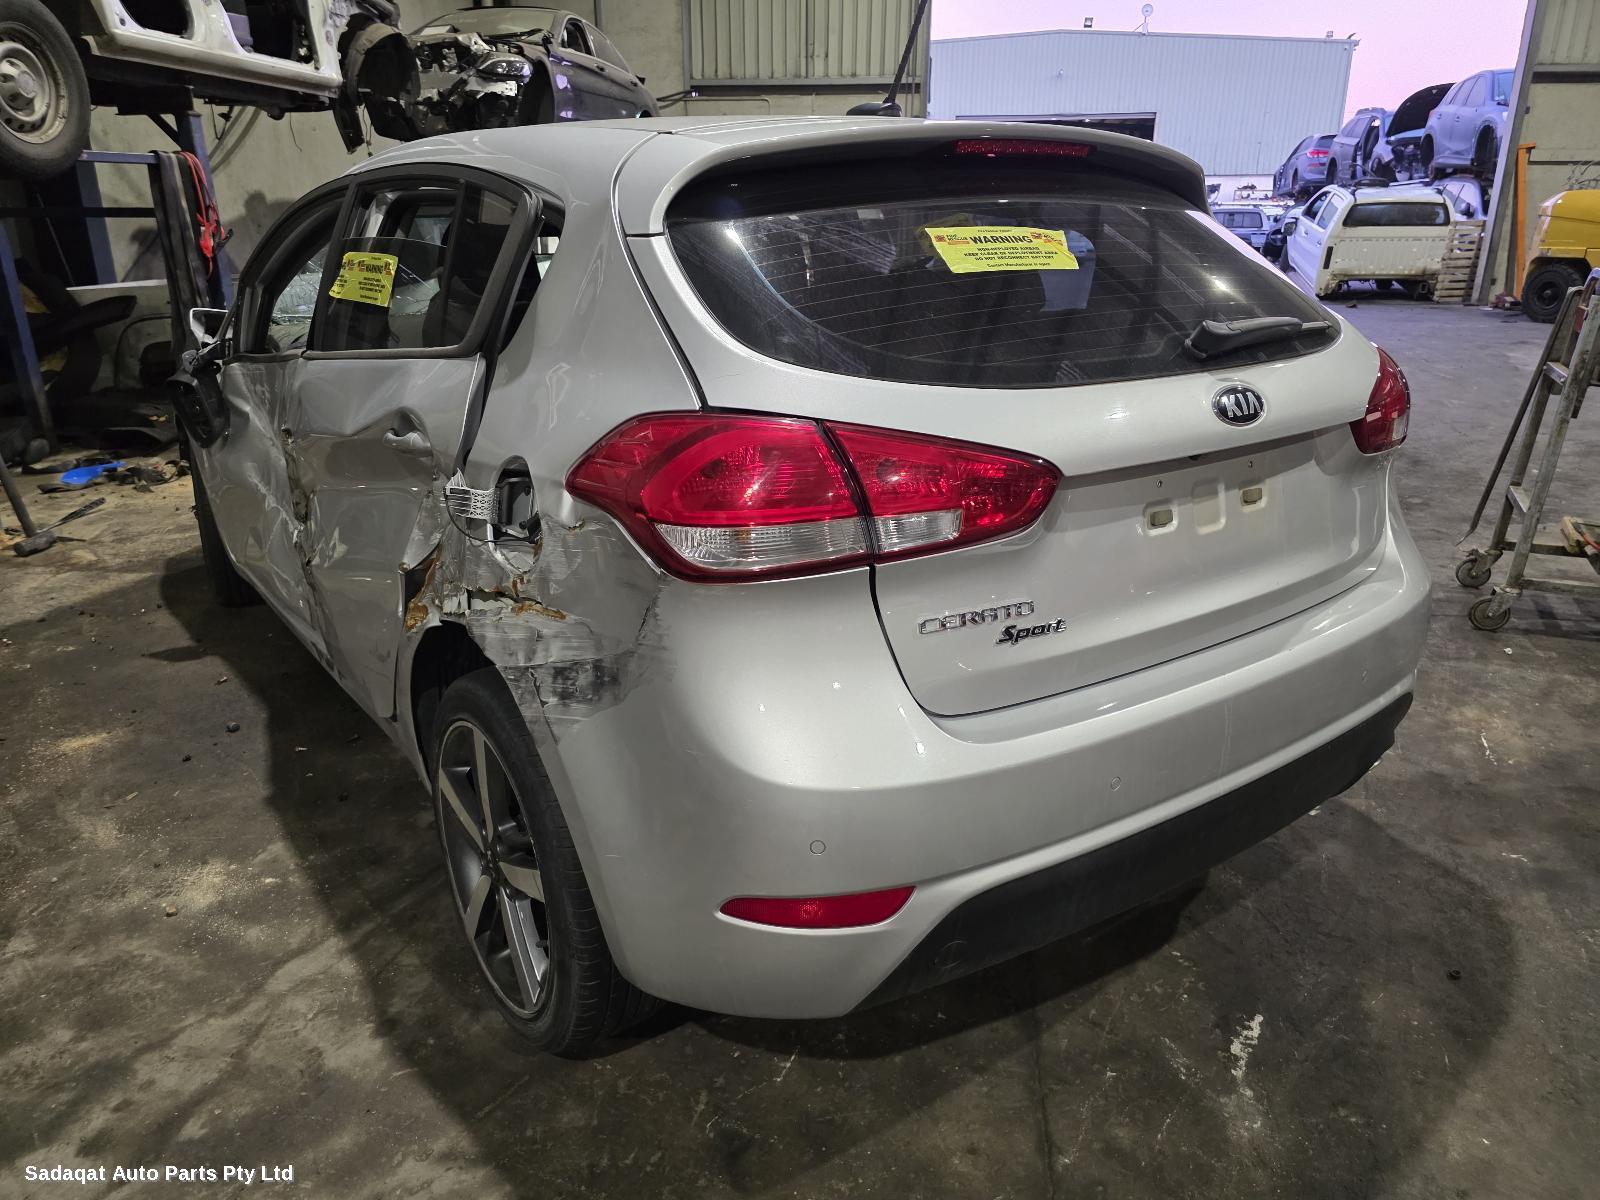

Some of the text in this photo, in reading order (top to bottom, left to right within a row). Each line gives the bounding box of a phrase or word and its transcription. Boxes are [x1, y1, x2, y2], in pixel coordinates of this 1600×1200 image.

[969, 235, 1033, 244] WARNING
[1221, 391, 1261, 417] KIA
[918, 600, 1035, 634] CERATO
[995, 617, 1067, 645] Sport
